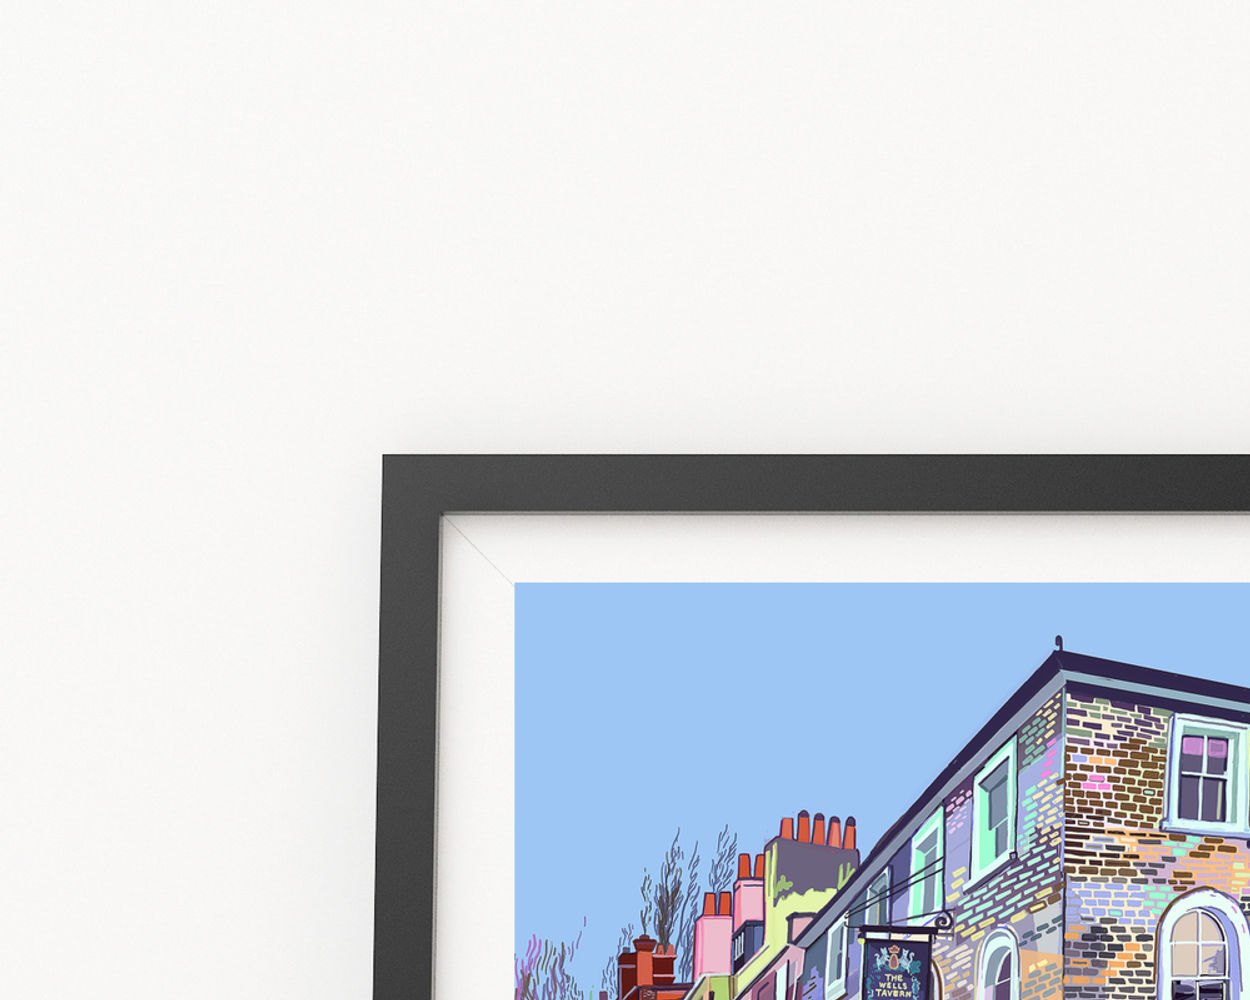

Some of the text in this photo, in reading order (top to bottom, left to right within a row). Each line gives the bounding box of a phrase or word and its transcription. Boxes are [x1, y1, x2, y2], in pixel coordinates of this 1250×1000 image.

[884, 973, 904, 982] THE
[879, 982, 907, 990] WELLS
[875, 988, 912, 998] TAVERN
